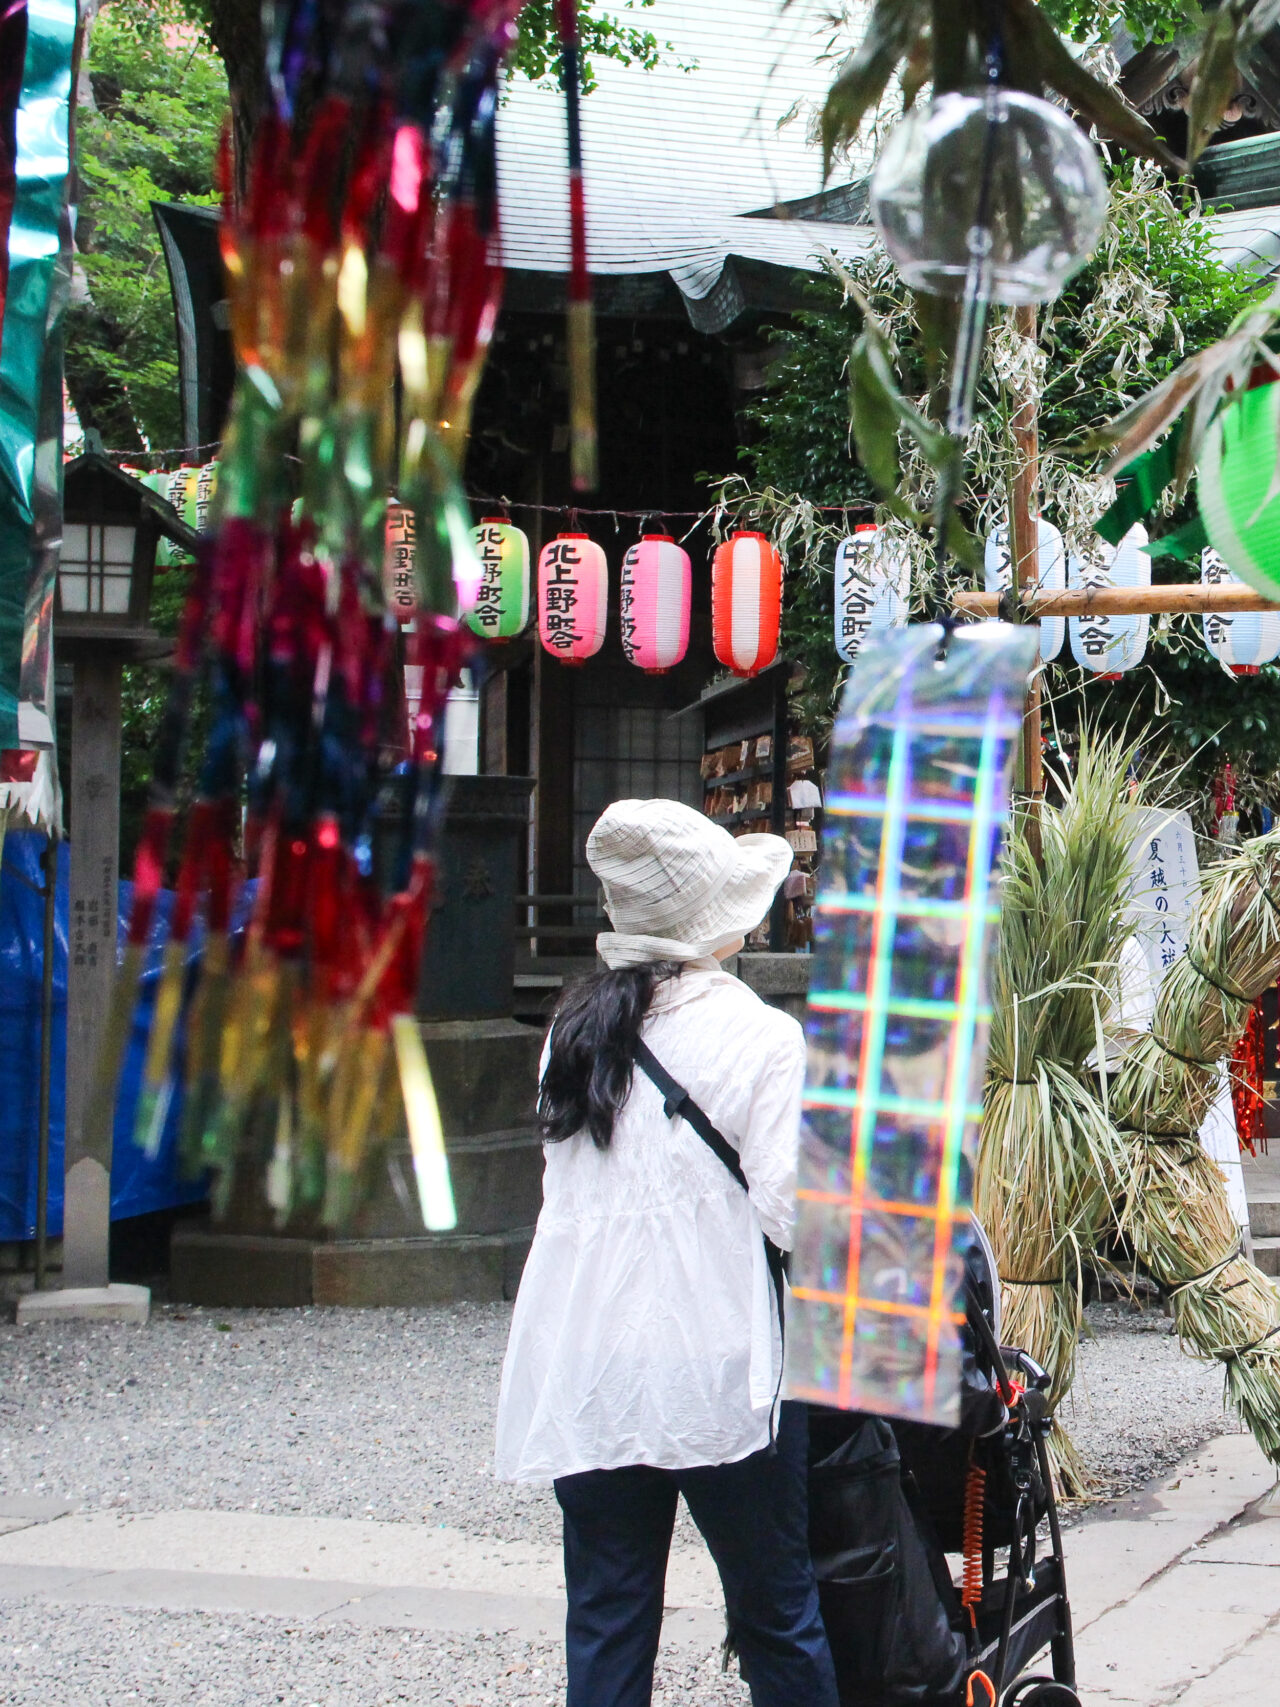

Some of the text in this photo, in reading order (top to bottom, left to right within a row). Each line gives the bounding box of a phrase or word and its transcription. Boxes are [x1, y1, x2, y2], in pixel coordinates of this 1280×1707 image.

[545, 544, 583, 649] 北上野町会
